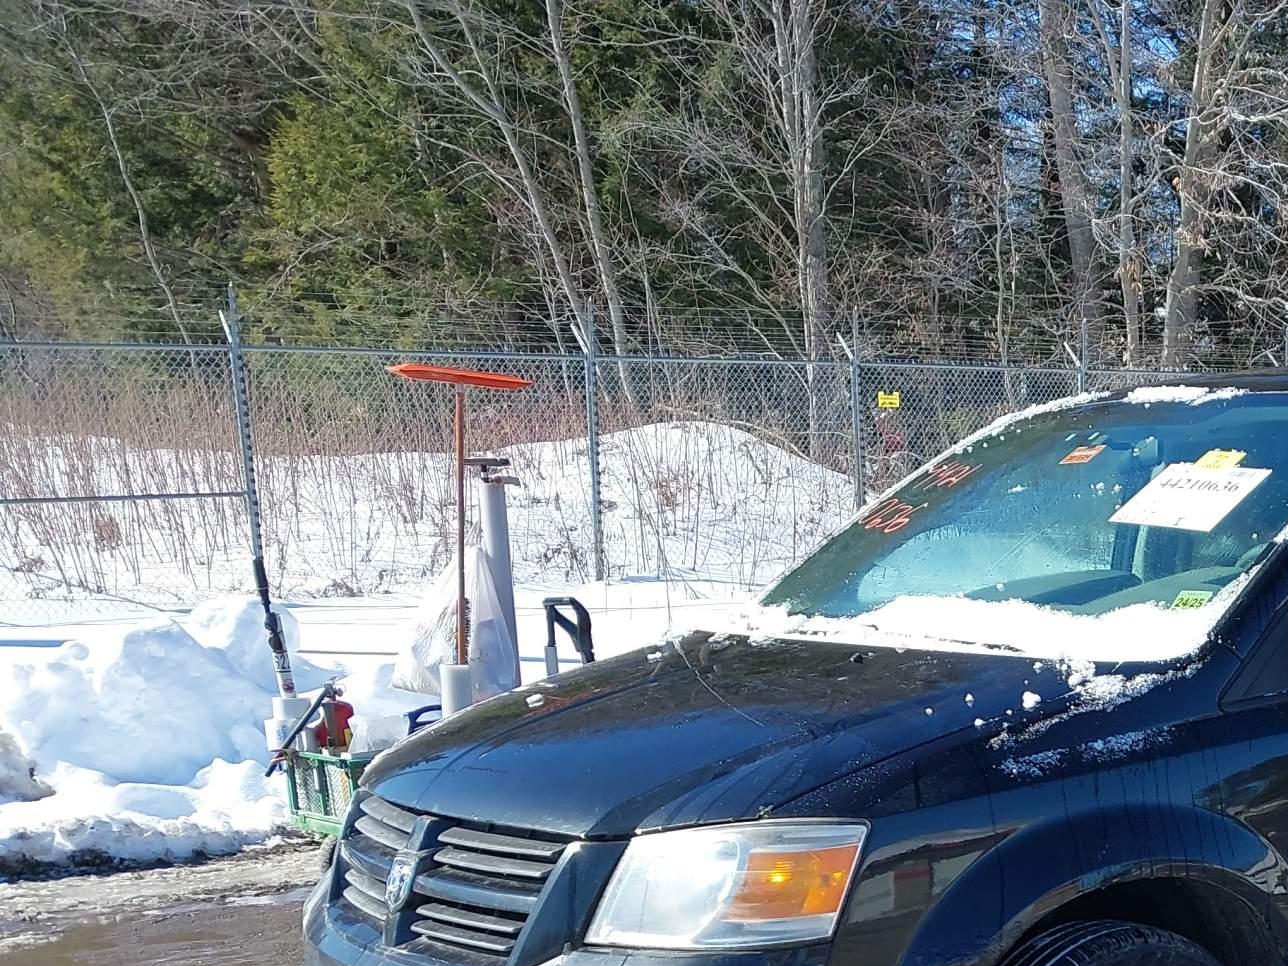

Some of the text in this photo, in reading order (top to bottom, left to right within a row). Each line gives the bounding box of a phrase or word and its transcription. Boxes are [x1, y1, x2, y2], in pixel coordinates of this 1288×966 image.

[1160, 477, 1240, 493] 44210636
[858, 498, 929, 533] 0636
[1174, 597, 1206, 608] 24/25
